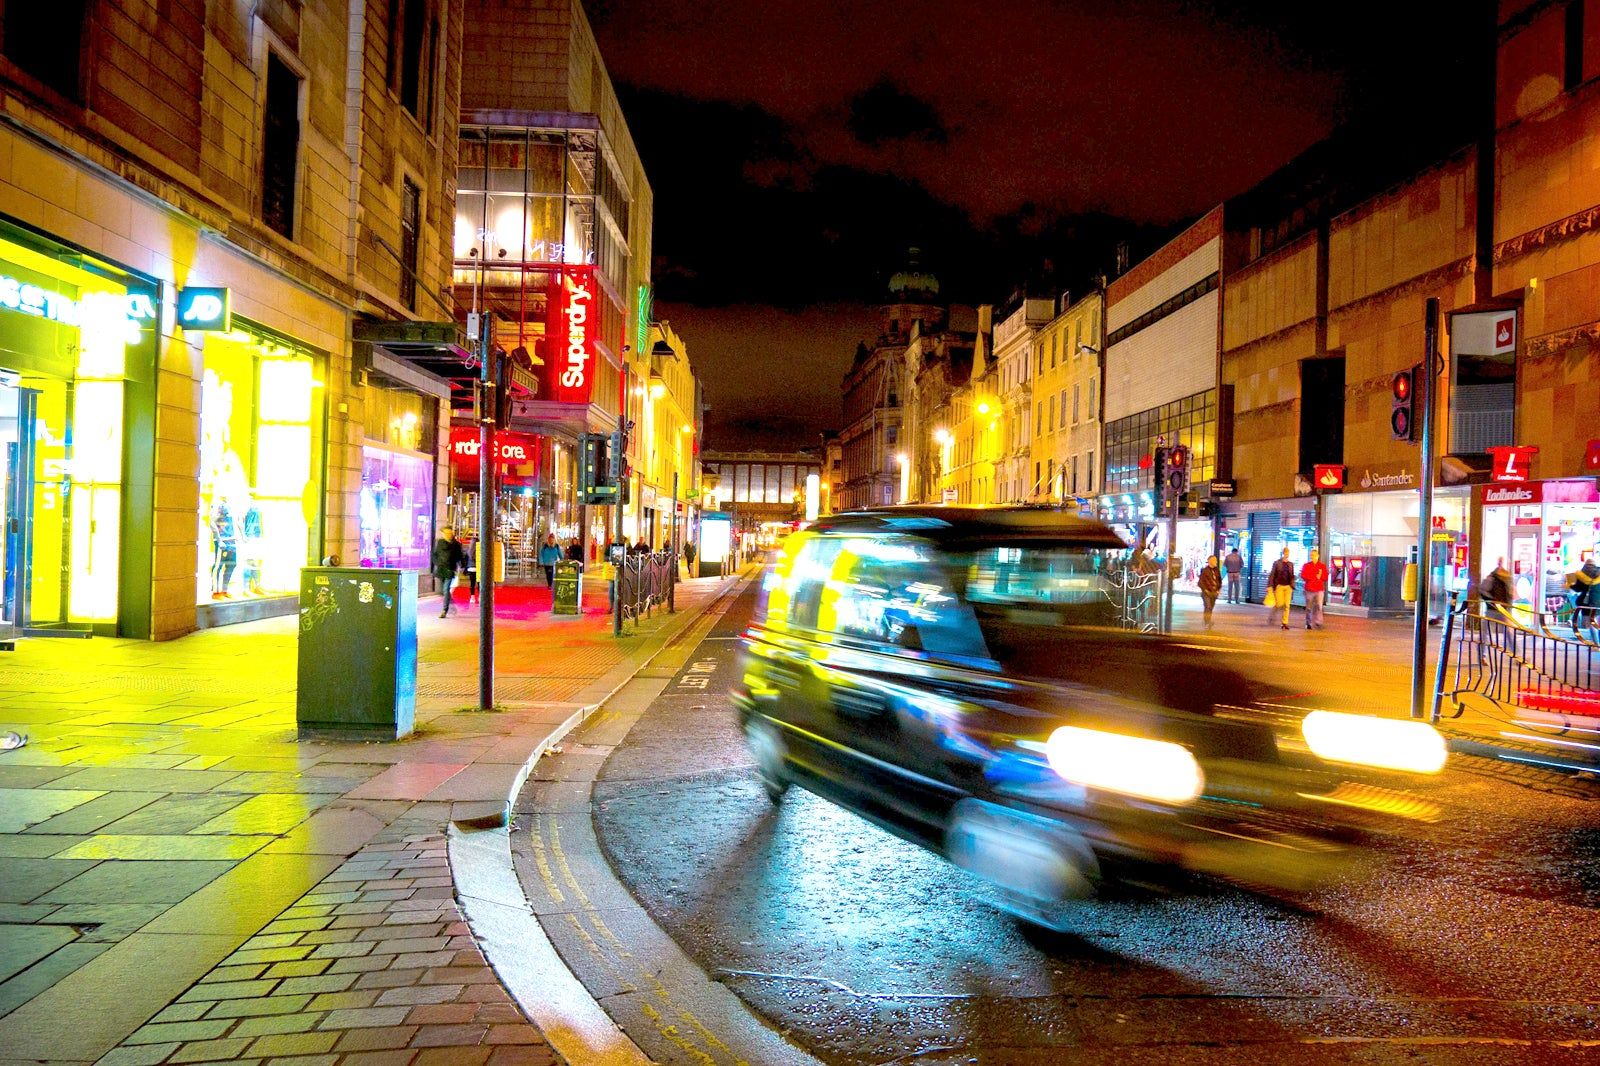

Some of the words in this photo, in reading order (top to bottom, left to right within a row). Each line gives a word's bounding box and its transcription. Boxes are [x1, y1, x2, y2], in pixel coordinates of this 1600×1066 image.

[184, 295, 222, 320] JD
[1505, 453, 1517, 474] L
[1371, 469, 1414, 487] Santander
[1486, 487, 1533, 502] Ladbrokes
